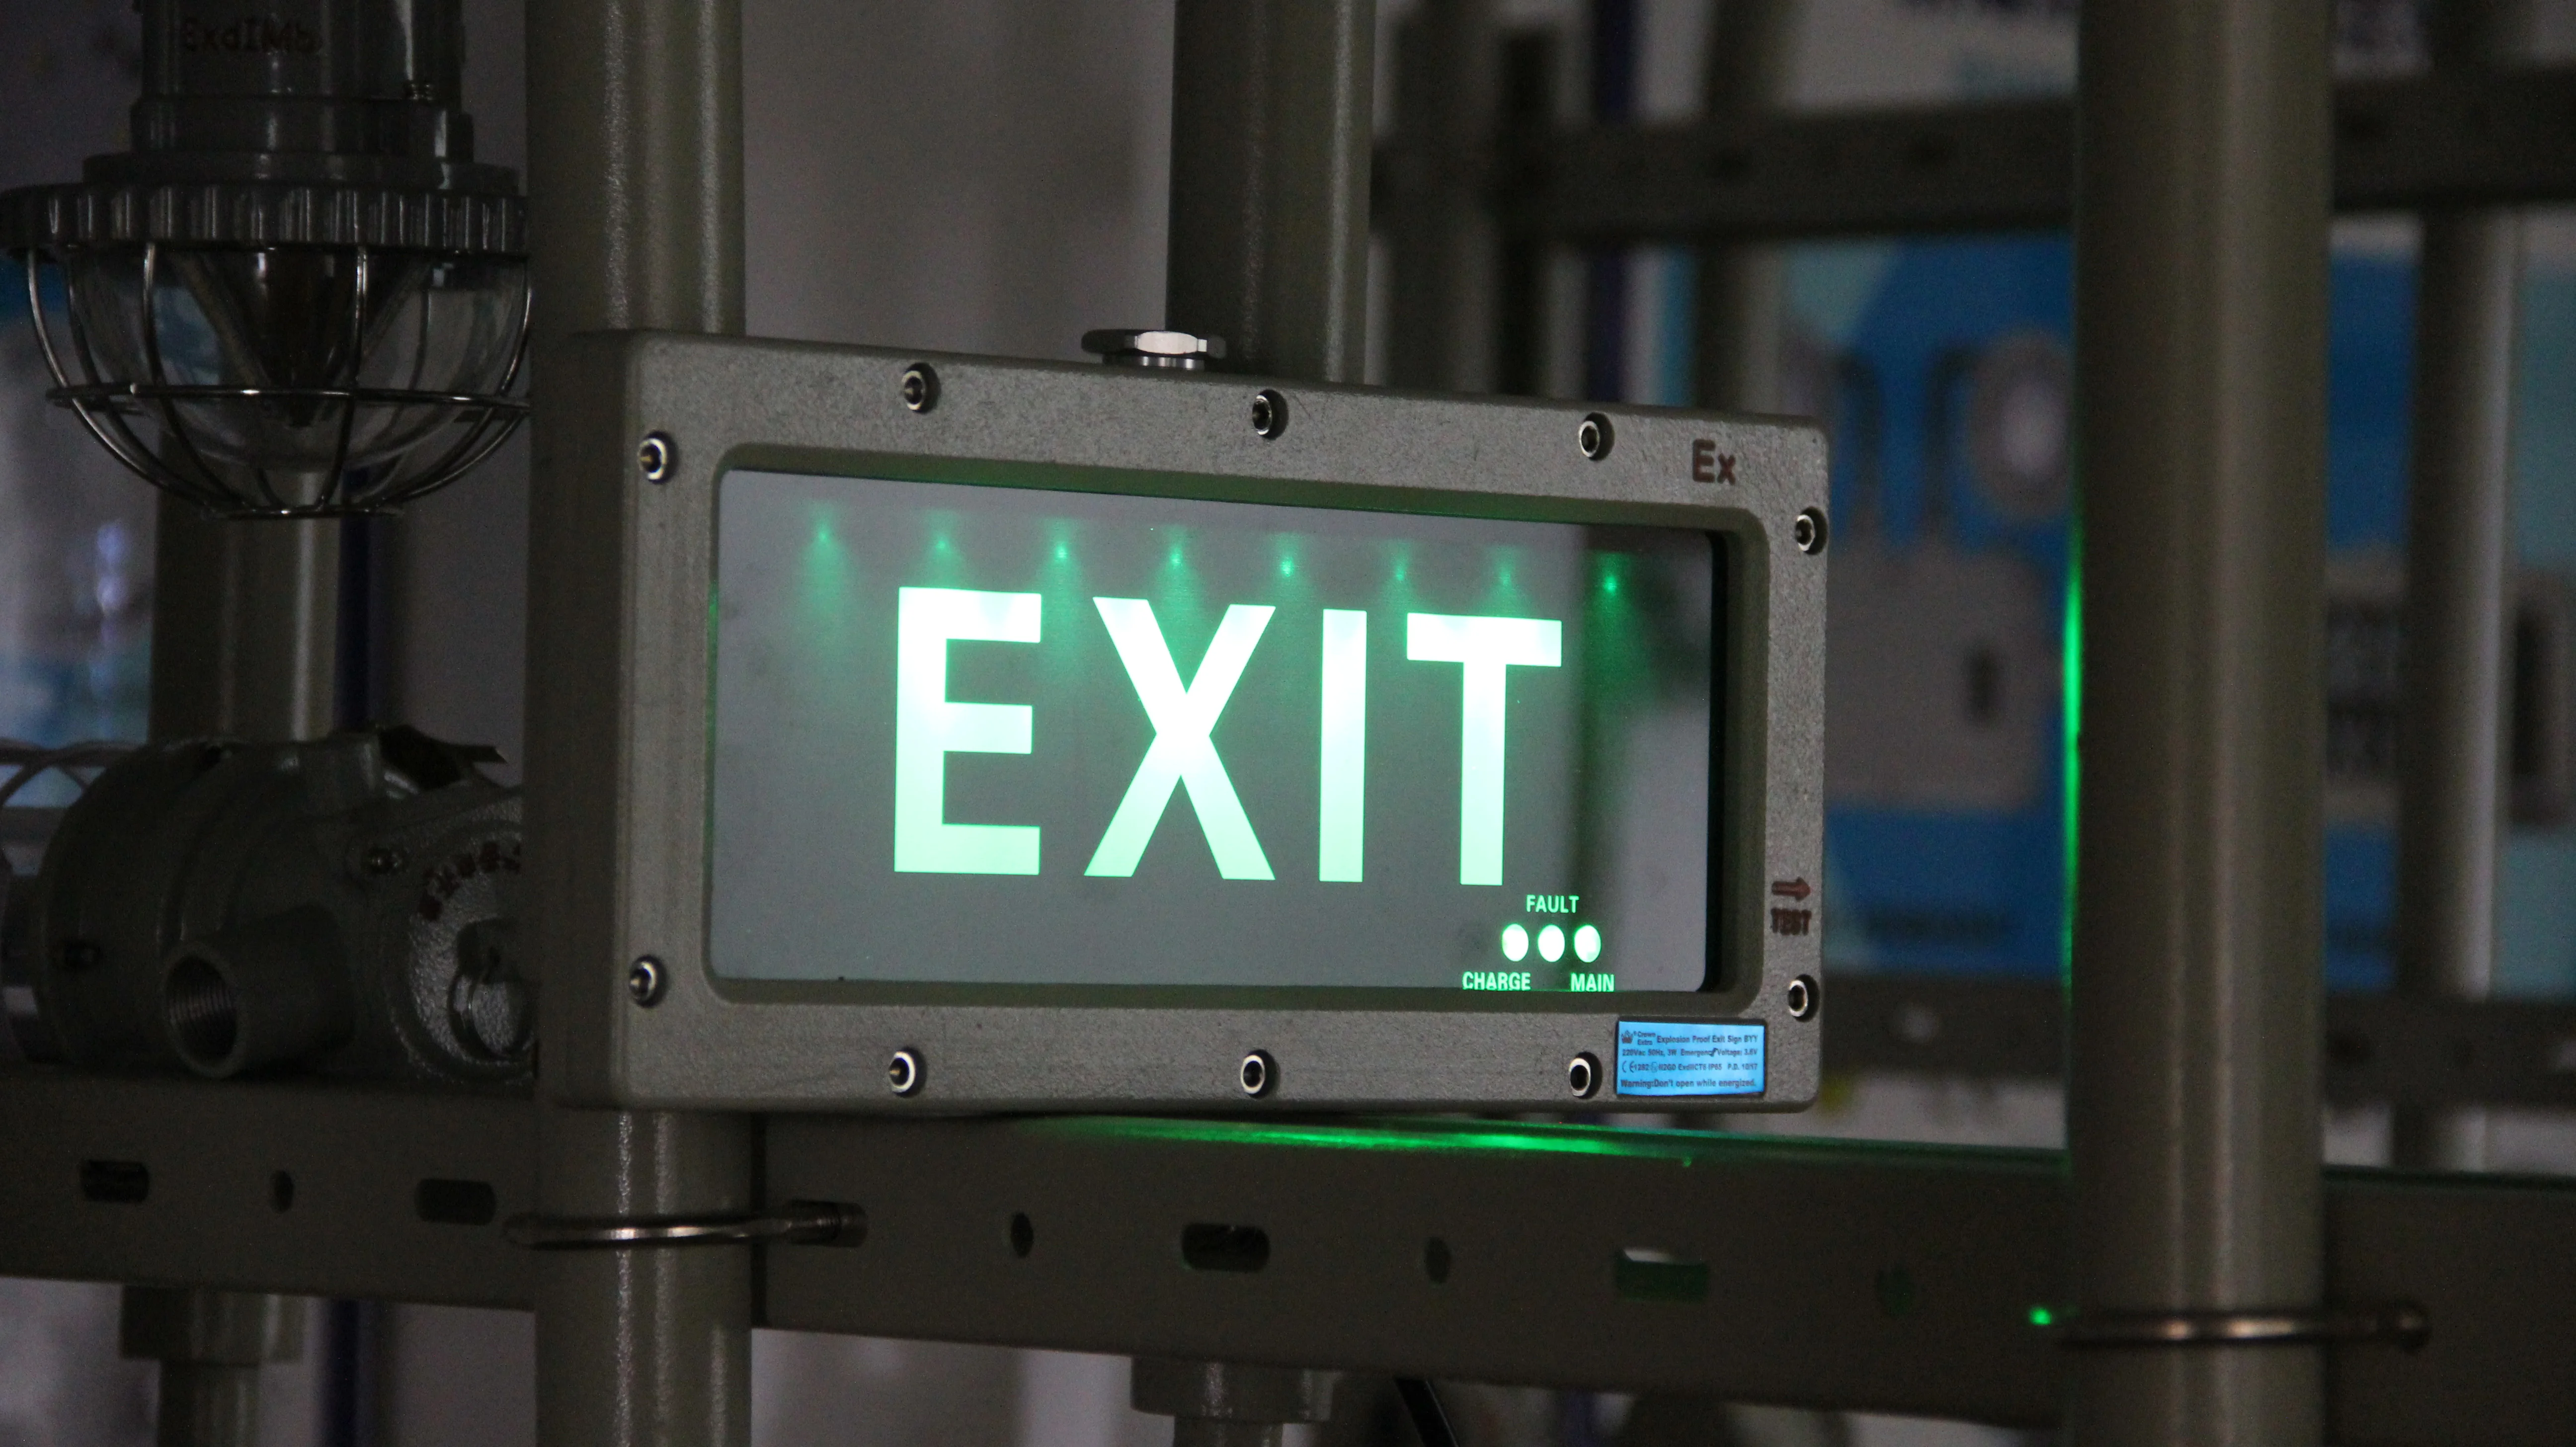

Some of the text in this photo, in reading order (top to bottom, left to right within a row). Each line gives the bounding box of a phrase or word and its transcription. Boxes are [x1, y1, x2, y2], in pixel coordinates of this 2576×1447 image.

[1692, 439, 1736, 485] Ex
[894, 586, 1562, 886] EXIT
[1526, 894, 1579, 913] FAULT
[1771, 907, 1812, 936] TEST
[1462, 971, 1531, 991] CHARGE
[1570, 972, 1614, 992] MAIN
[1657, 1035, 1690, 1045] Explosion
[1727, 1036, 1742, 1045] Sign
[1719, 1079, 1756, 1088] energized.
